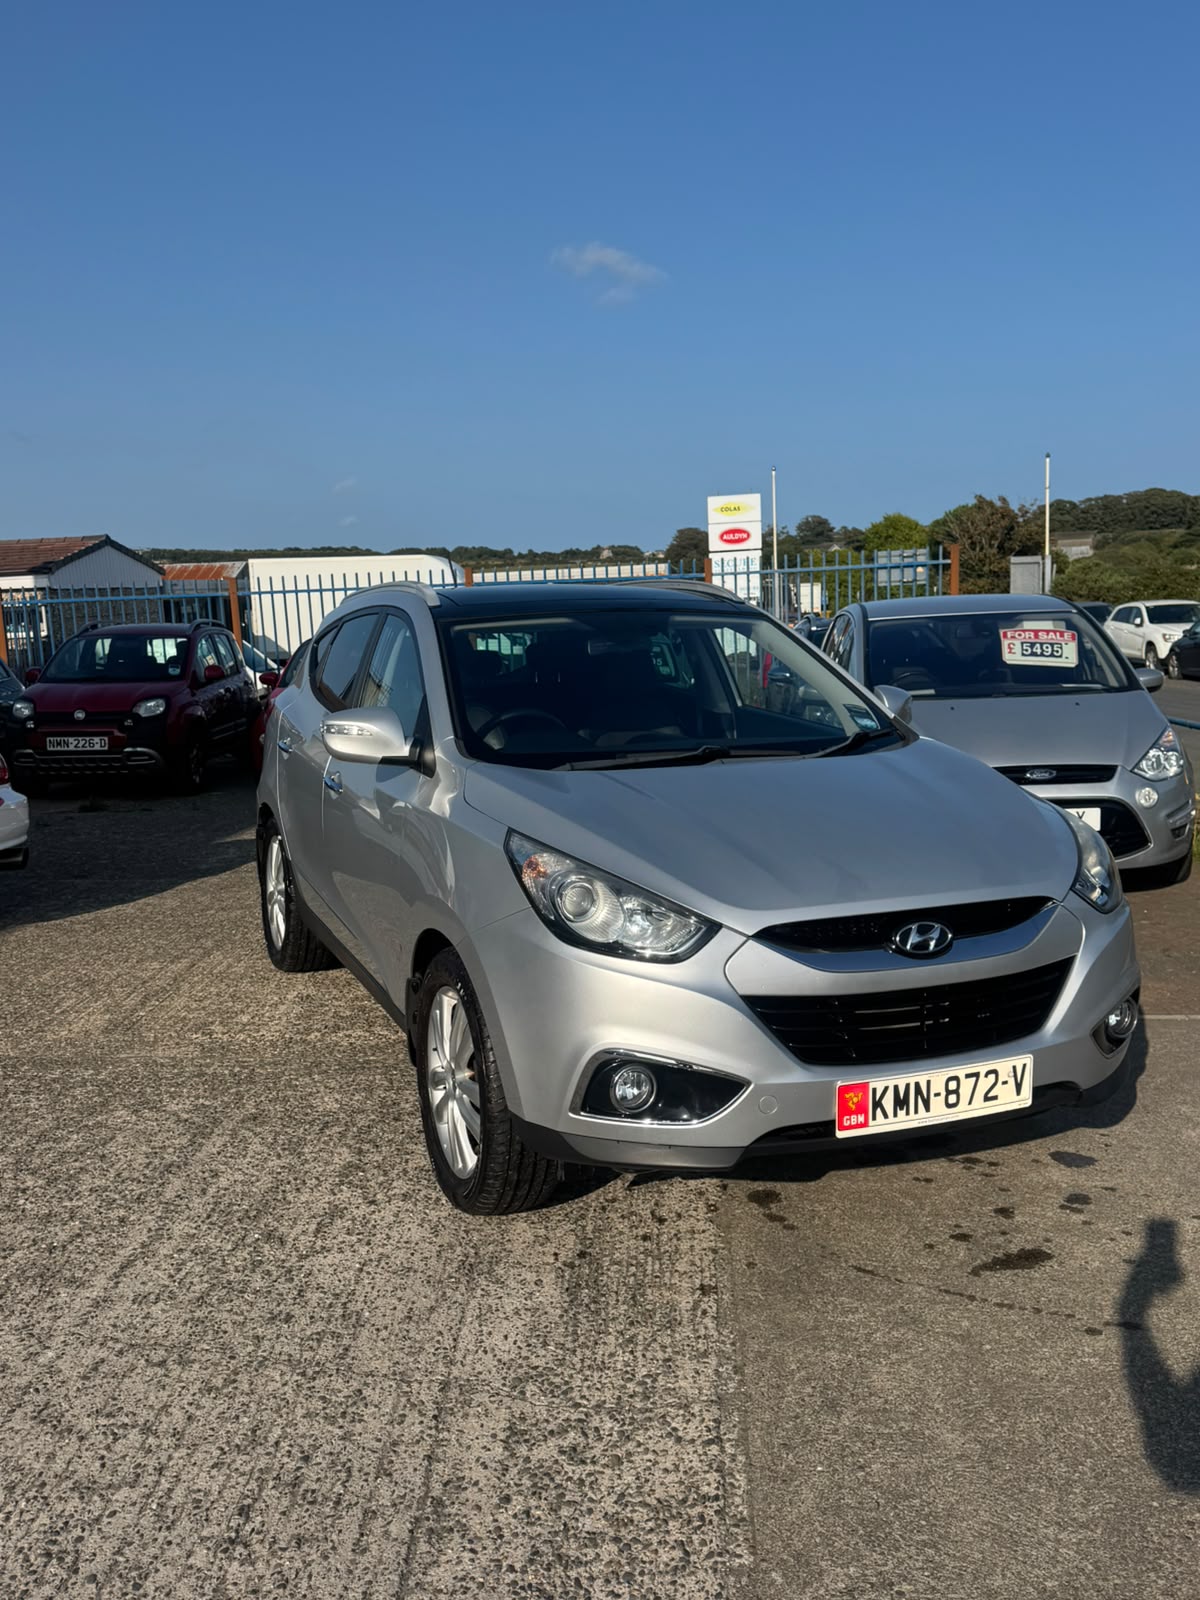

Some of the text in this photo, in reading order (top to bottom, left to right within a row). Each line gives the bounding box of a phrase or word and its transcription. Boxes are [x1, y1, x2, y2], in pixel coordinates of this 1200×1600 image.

[1006, 631, 1072, 640] FOR SALE
[1022, 643, 1062, 656] 5495
[48, 738, 107, 749] NMN-226-D
[871, 1063, 1027, 1121] KMN-872-V
[843, 1113, 865, 1127] GBM
